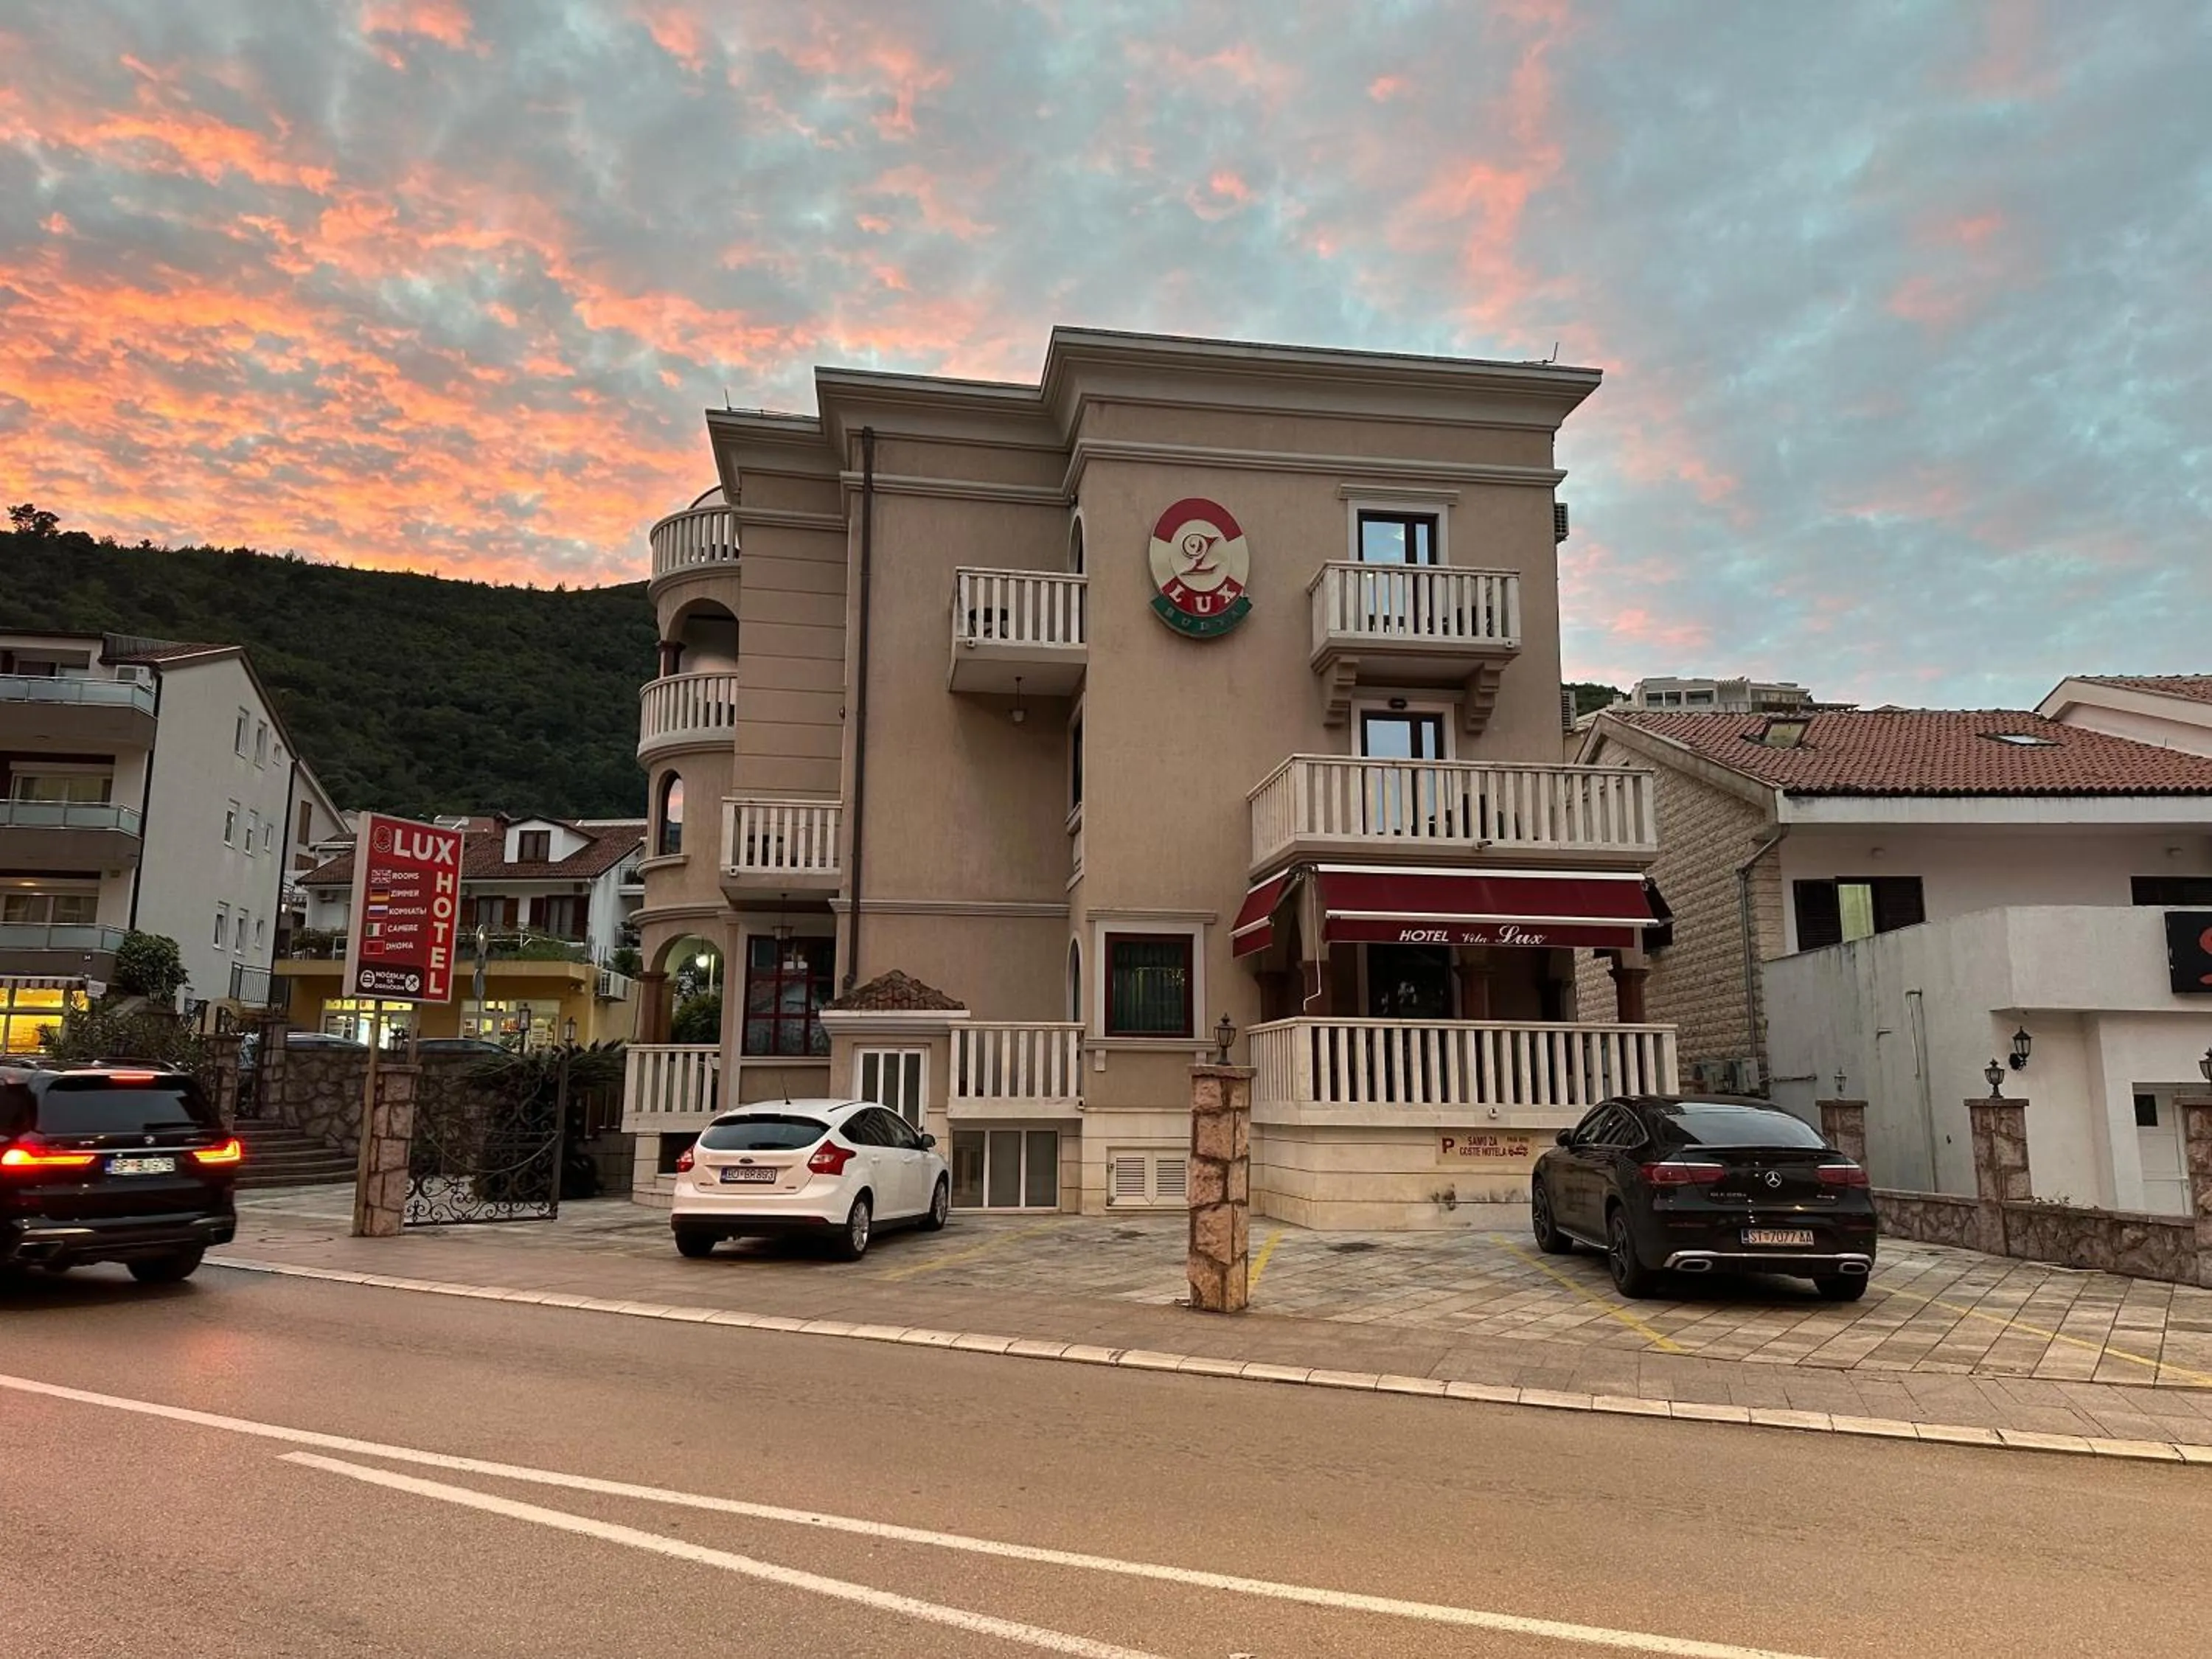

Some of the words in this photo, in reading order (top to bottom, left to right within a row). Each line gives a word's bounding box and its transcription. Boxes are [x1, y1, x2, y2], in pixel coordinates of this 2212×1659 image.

[1169, 583, 1237, 613] LUX
[393, 828, 455, 865] LUX
[392, 872, 420, 880] ROOMS
[390, 889, 420, 897] ZIMMER
[387, 924, 419, 933] CAMERE
[429, 871, 453, 995] HOTEL
[1399, 930, 1450, 942] HOTEL
[1495, 925, 1548, 945] Lux
[1441, 1137, 1455, 1154] P
